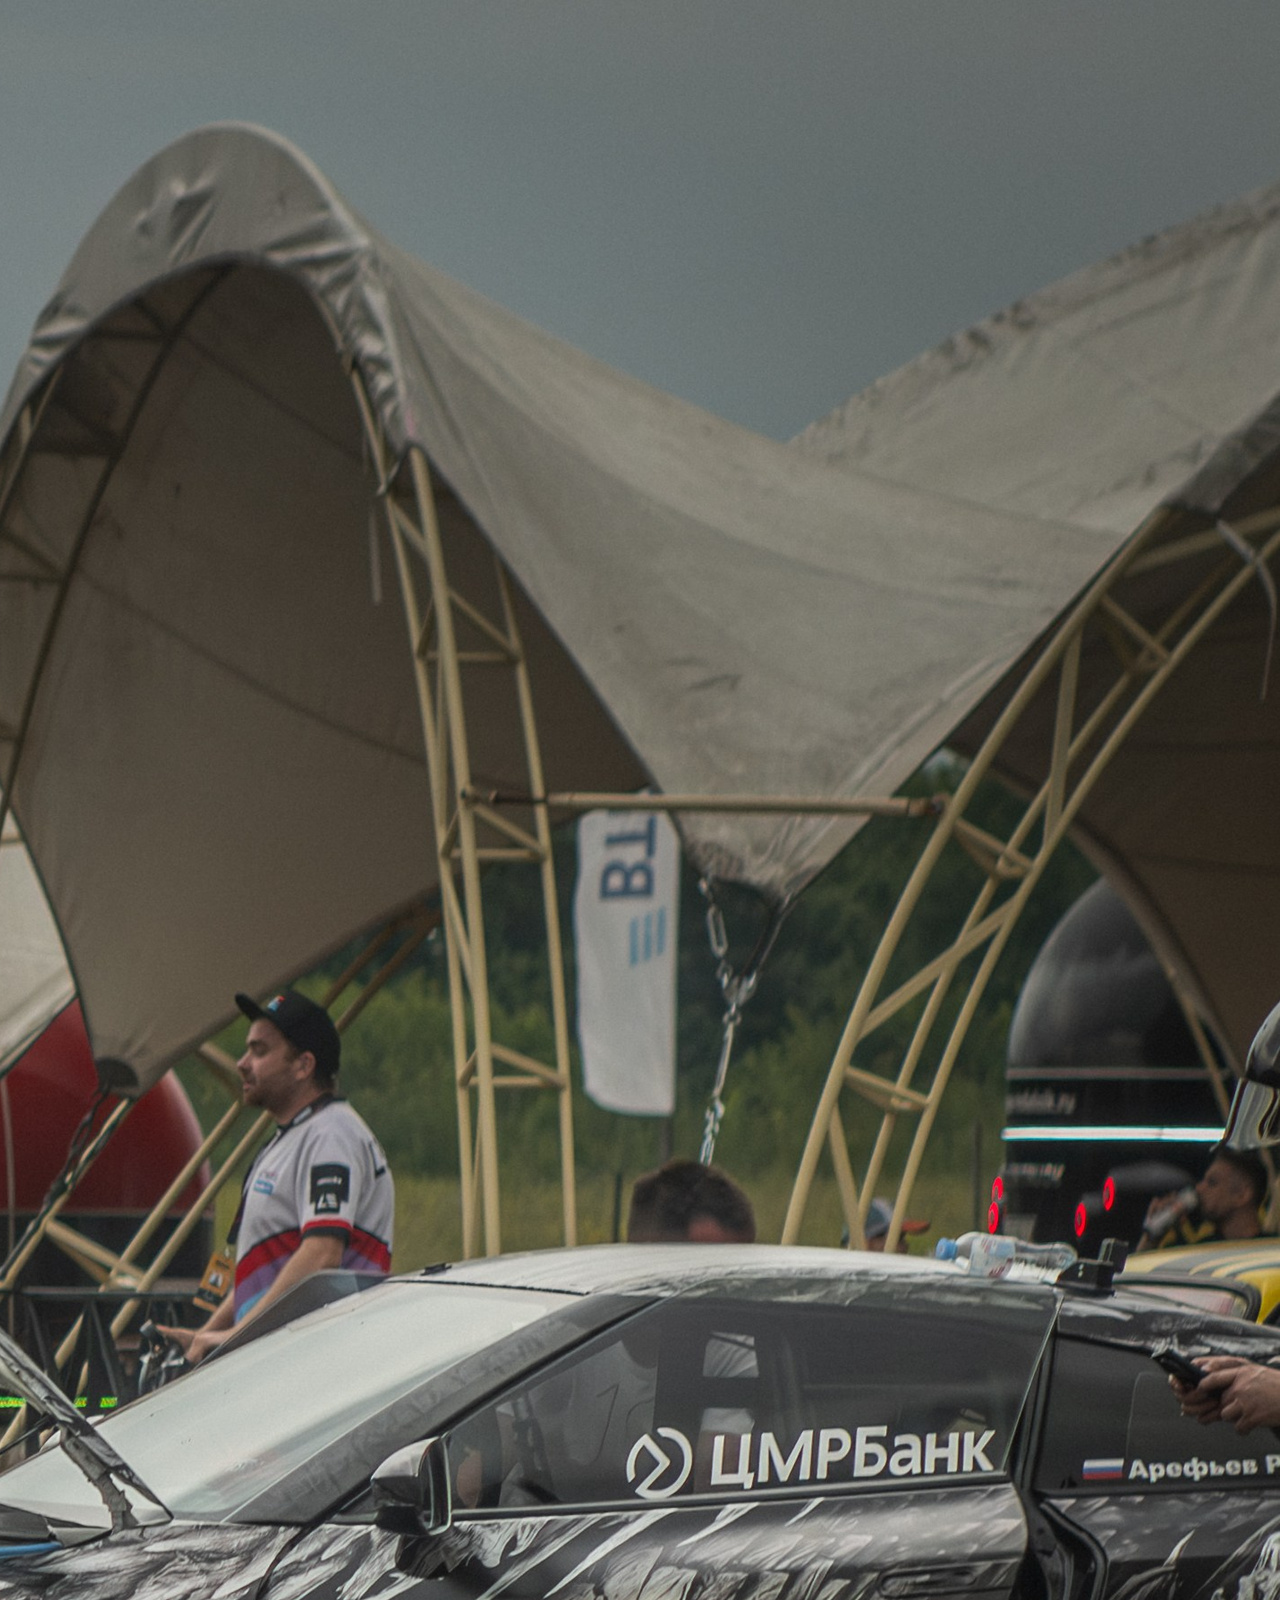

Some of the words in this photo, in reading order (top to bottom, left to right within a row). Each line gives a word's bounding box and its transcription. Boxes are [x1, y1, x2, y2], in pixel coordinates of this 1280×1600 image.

[599, 808, 657, 899] ВТ
[710, 1425, 997, 1489] ЦМРБанк
[1128, 1456, 1259, 1484] Арефьев
